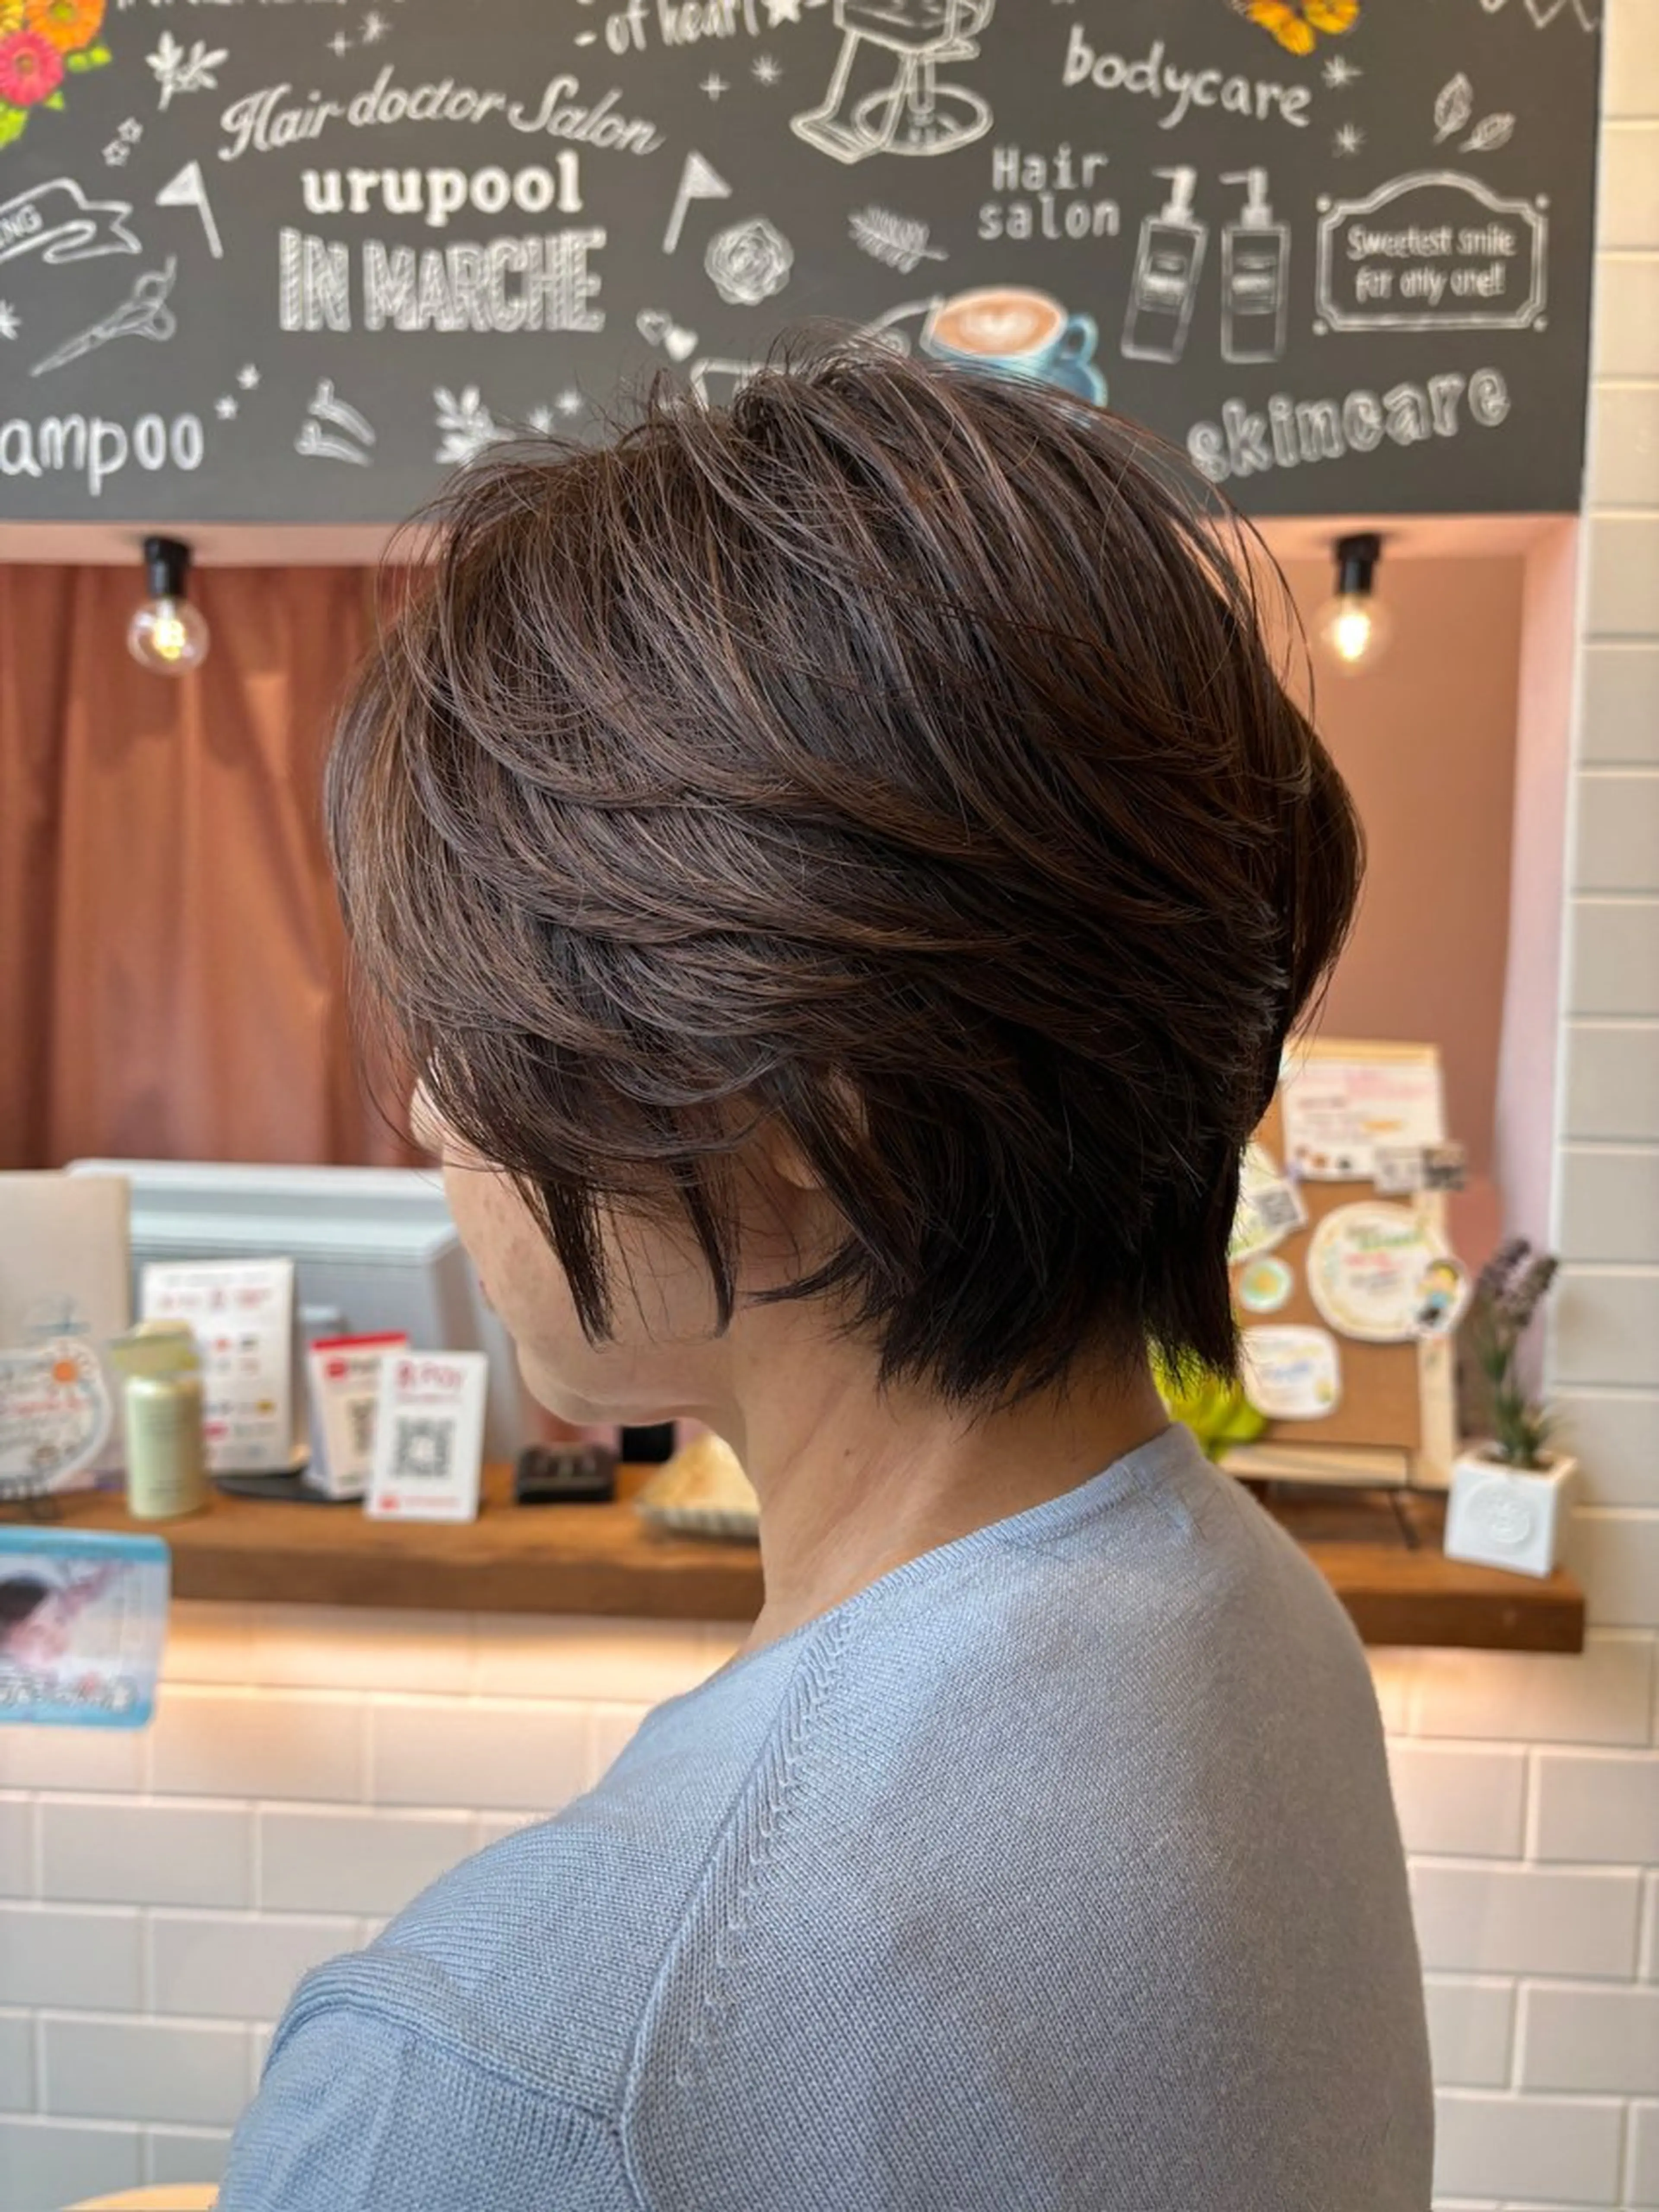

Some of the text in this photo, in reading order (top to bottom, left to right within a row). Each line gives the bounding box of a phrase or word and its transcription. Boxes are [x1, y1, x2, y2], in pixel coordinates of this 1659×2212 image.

[217, 64, 666, 161] Hair doctor Salon
[1062, 22, 1312, 129] bodycare
[300, 149, 583, 227] urupool
[992, 142, 1109, 191] Hair
[977, 191, 1120, 241] salon
[1347, 222, 1516, 261] Sweetest smile
[279, 226, 607, 333] IN MARCHE
[1399, 265, 1448, 306] only
[1187, 367, 1511, 484] skincare
